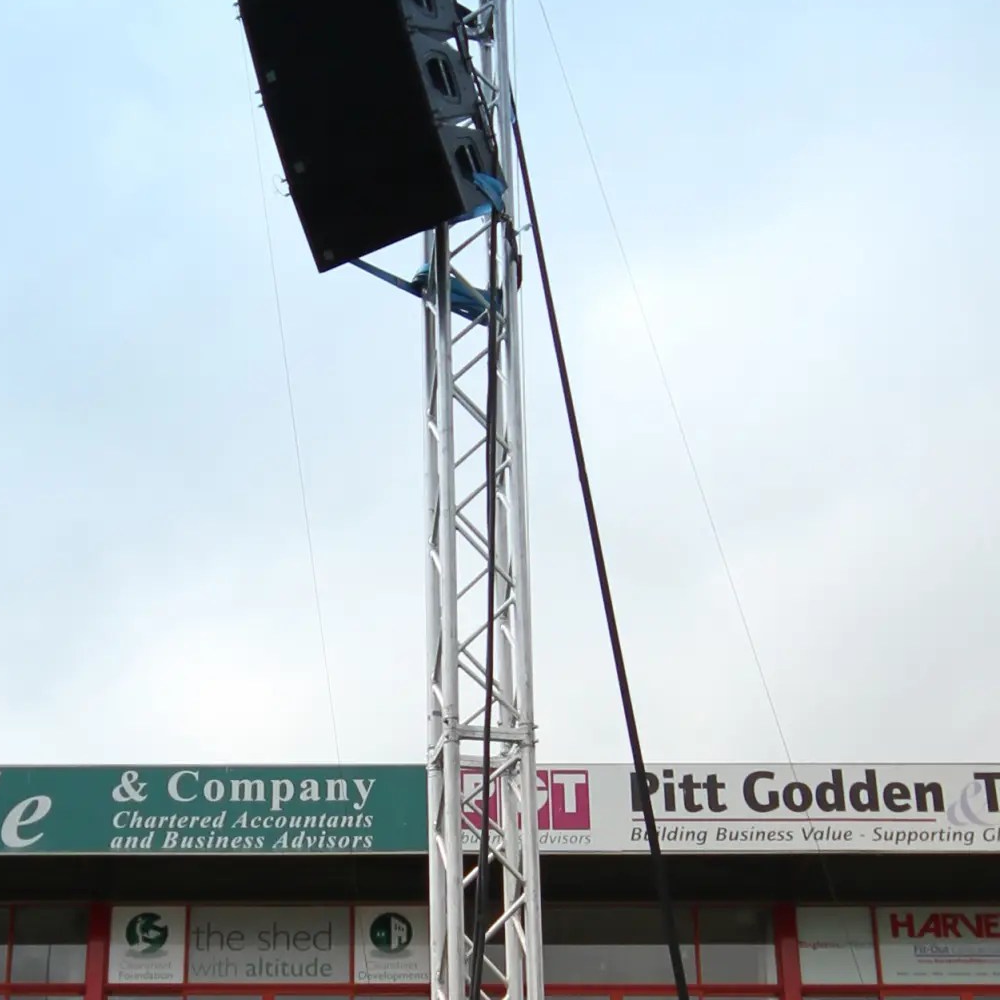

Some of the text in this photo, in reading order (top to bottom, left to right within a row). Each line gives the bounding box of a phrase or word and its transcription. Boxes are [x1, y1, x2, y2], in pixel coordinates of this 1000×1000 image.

[111, 769, 376, 810] & Company
[630, 769, 728, 813] Pitt
[742, 769, 945, 813] Godden
[112, 810, 374, 829] Chartered Accountants
[110, 830, 373, 850] and Business Advisors
[715, 827, 794, 843] Business
[800, 827, 853, 843] Value
[872, 826, 975, 846] Supporting
[192, 921, 333, 952] the shed
[191, 956, 240, 978] with
[245, 957, 333, 978] altitude
